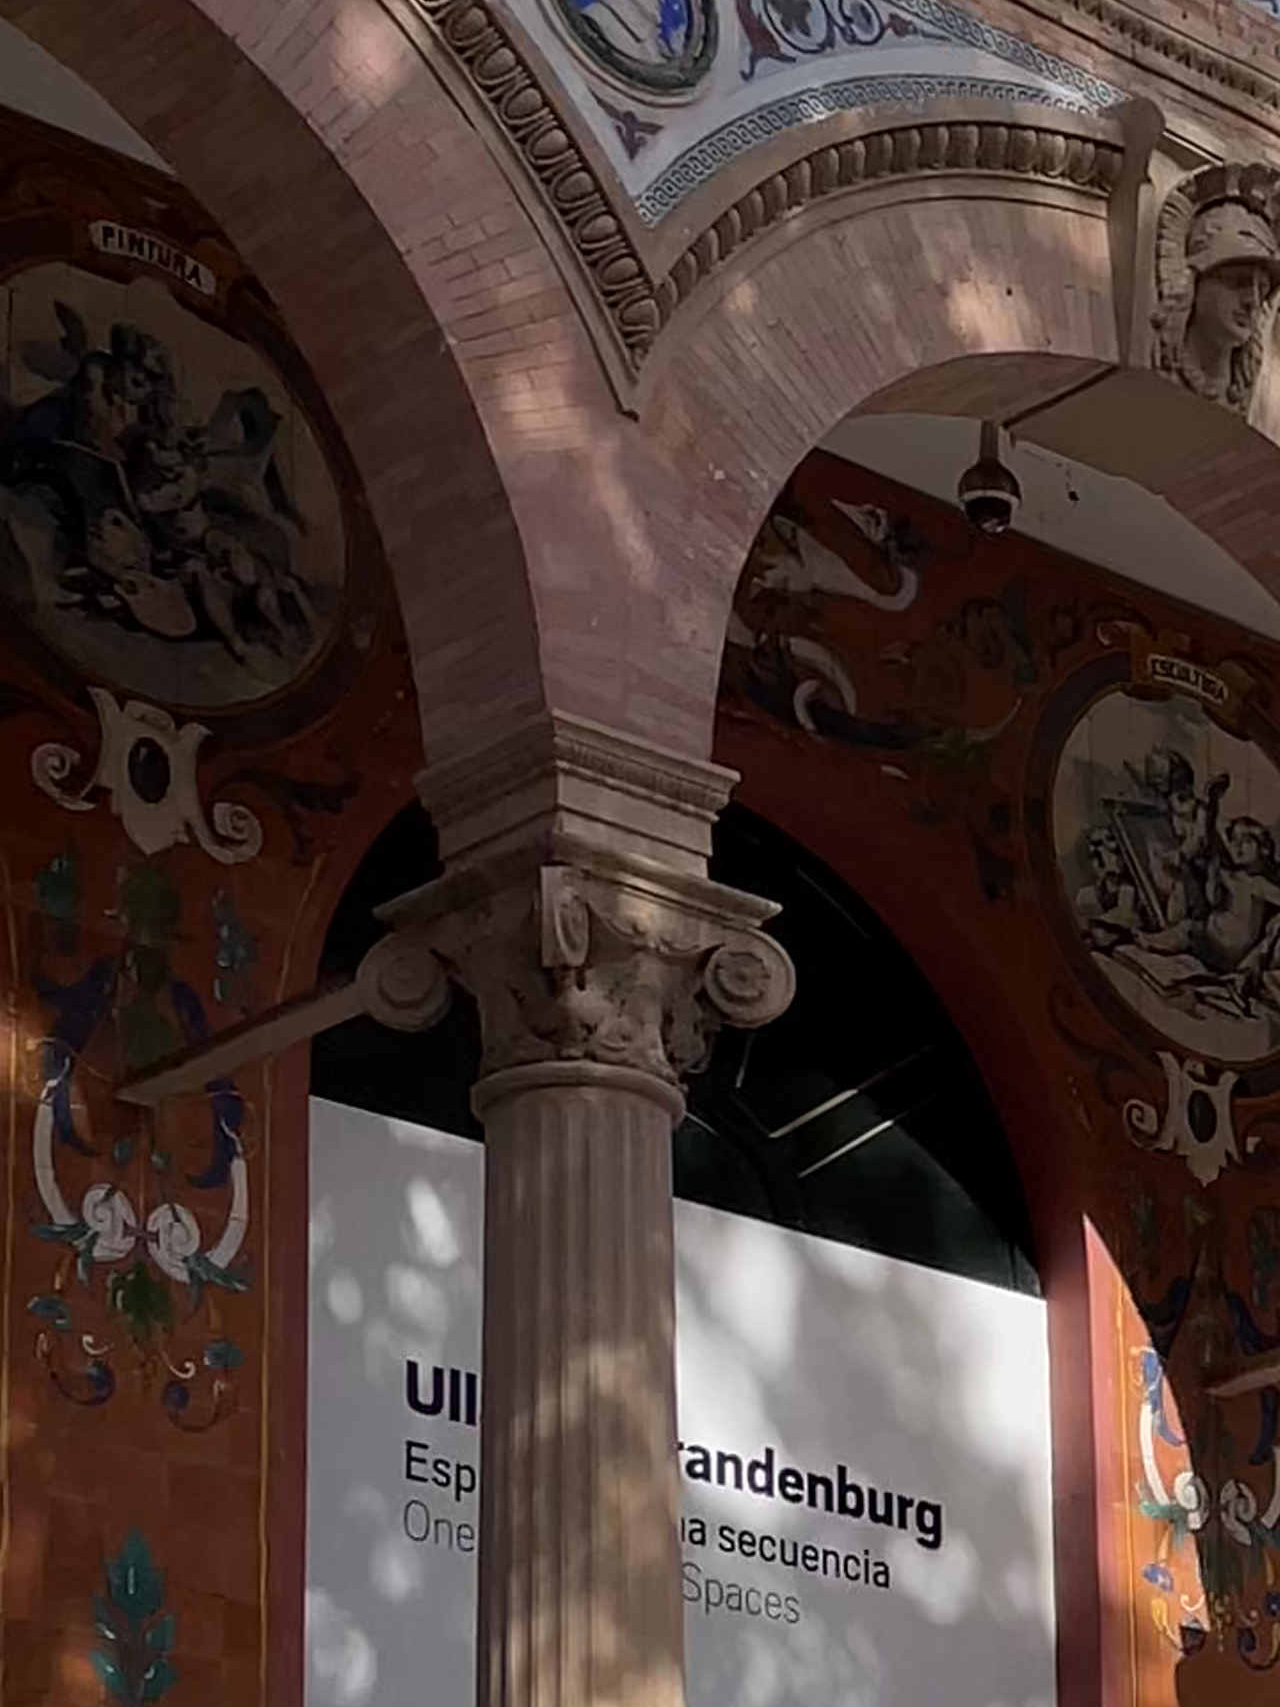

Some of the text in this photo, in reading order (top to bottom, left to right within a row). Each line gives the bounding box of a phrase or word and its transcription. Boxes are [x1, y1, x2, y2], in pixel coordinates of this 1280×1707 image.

[102, 226, 202, 287] PINTURA
[405, 1440, 477, 1502] Esp
[718, 1525, 892, 1589] secuencia
[406, 1359, 943, 1549] Ull andenburg
[403, 1499, 801, 1624] One Spaces
